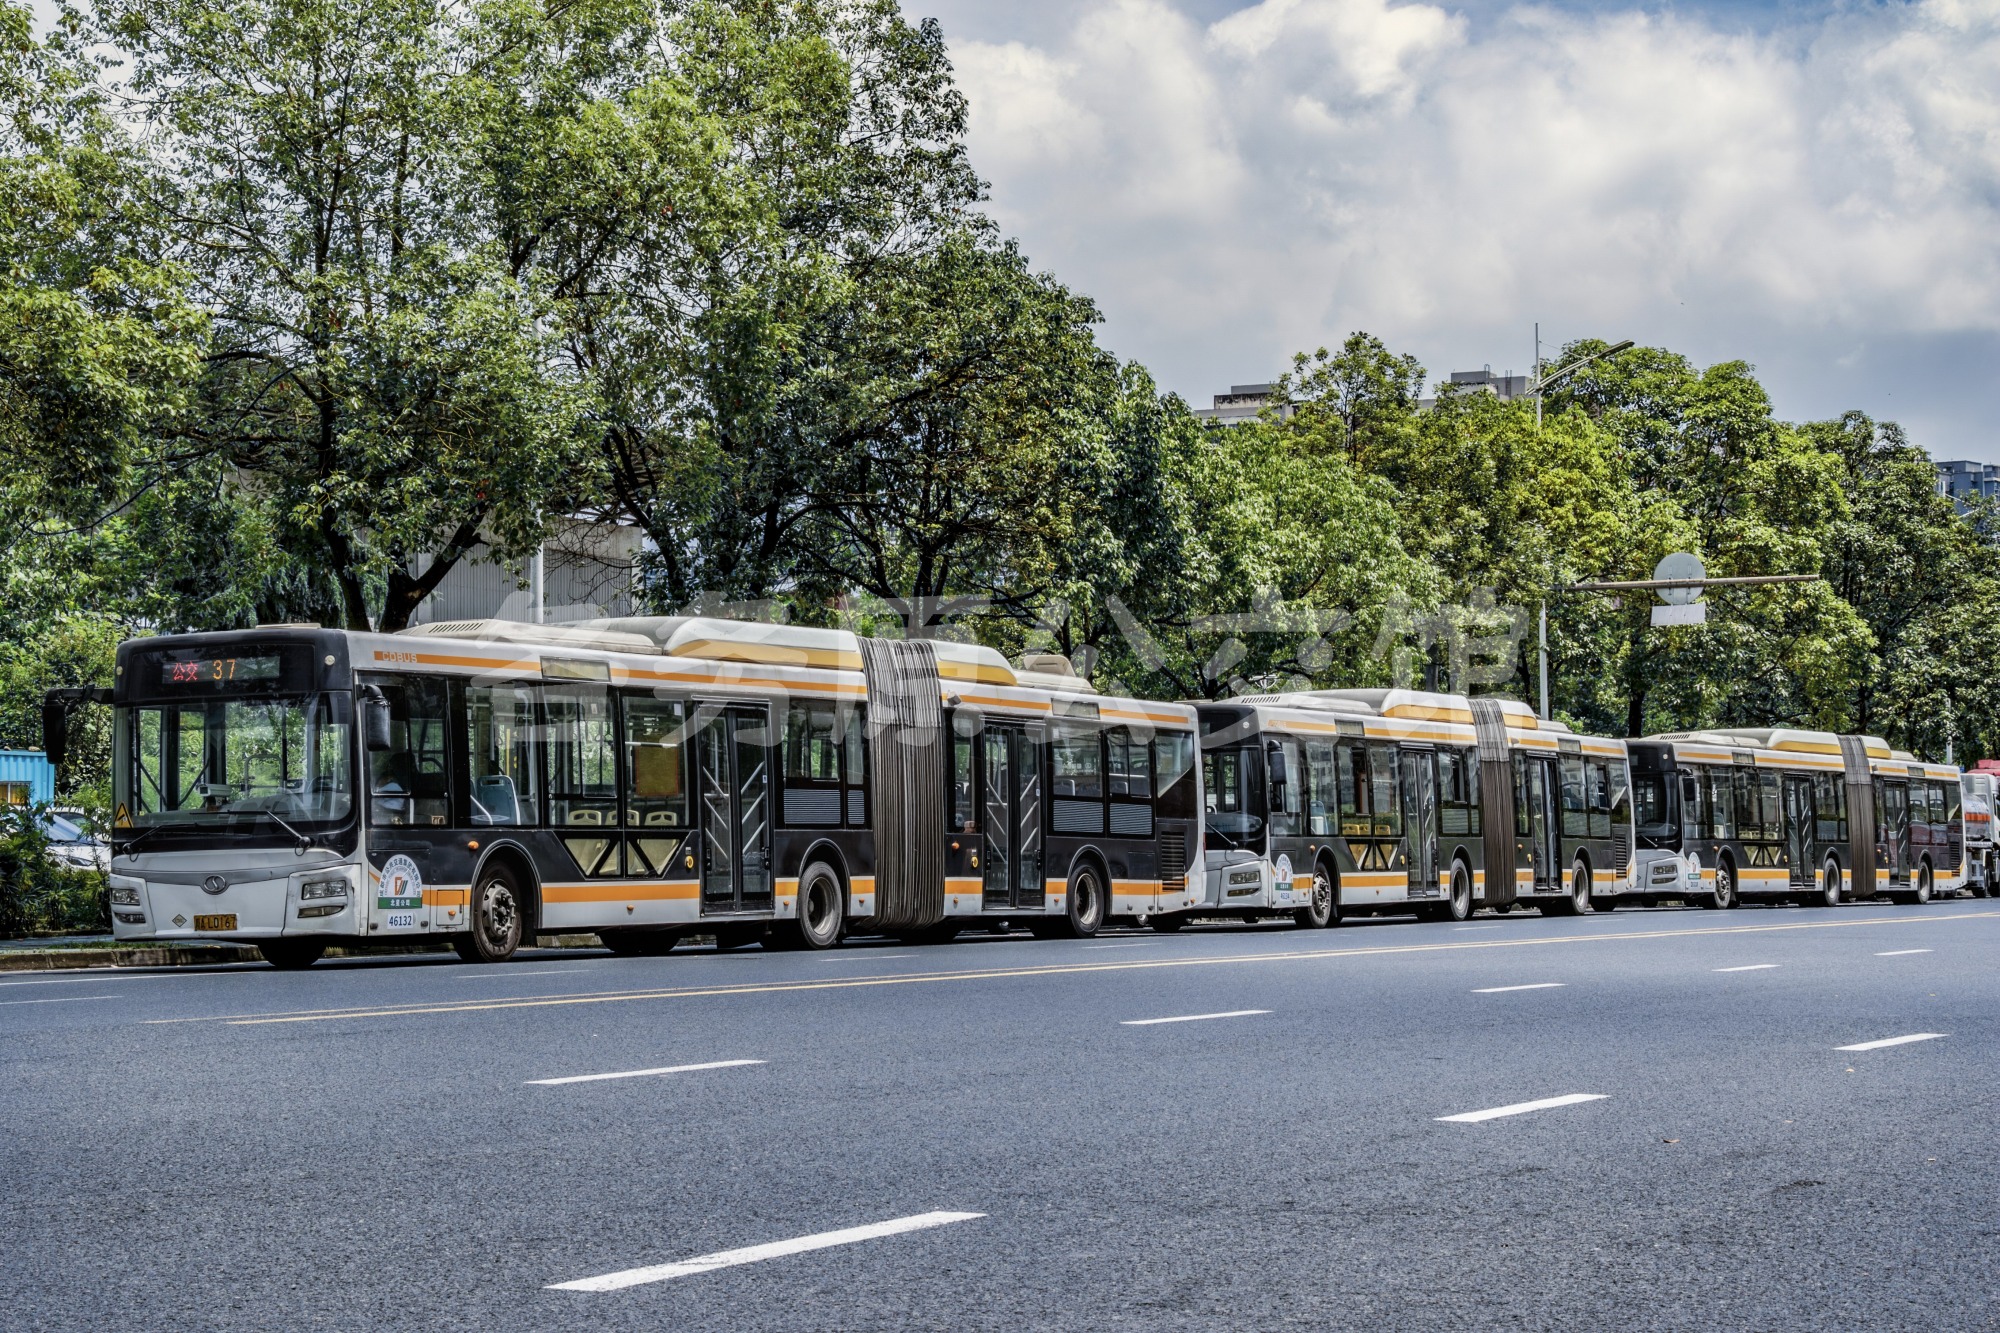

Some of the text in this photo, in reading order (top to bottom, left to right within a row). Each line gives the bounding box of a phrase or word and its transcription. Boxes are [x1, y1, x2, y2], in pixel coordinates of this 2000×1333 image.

[173, 659, 236, 681] 公交 37
[389, 915, 412, 926] 46132
